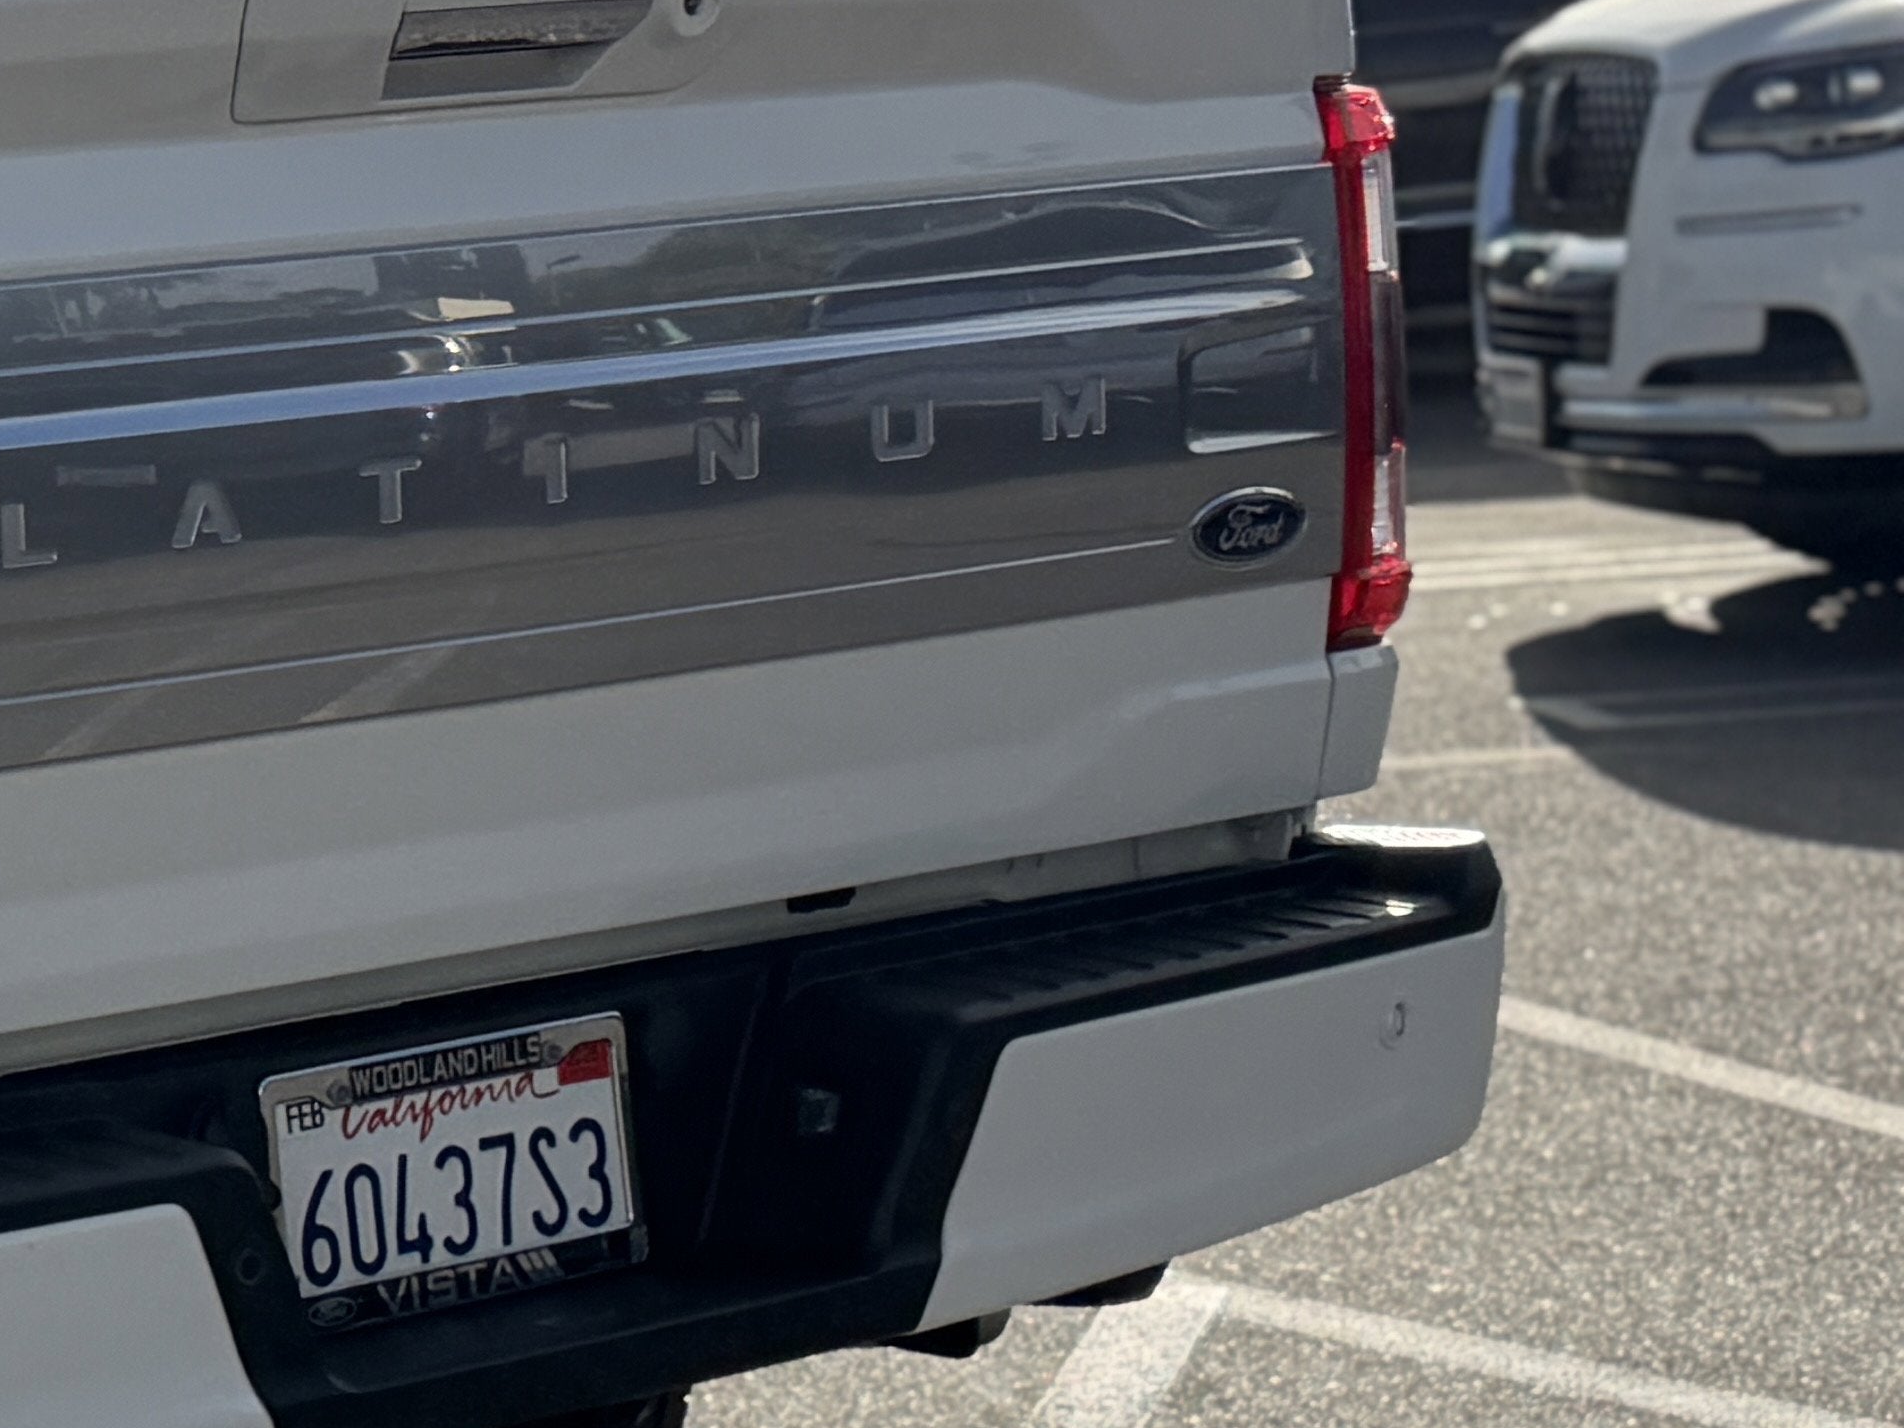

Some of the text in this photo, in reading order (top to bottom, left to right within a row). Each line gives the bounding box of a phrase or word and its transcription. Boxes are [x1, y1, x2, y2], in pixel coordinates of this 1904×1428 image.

[1219, 503, 1285, 552] Ford
[352, 1047, 479, 1095] WOODLAND
[482, 1036, 542, 1068] HILLS
[287, 1100, 325, 1134] FEB
[342, 1072, 560, 1142] California
[302, 1118, 613, 1287] 60437S3
[377, 1257, 524, 1314] VISTA
